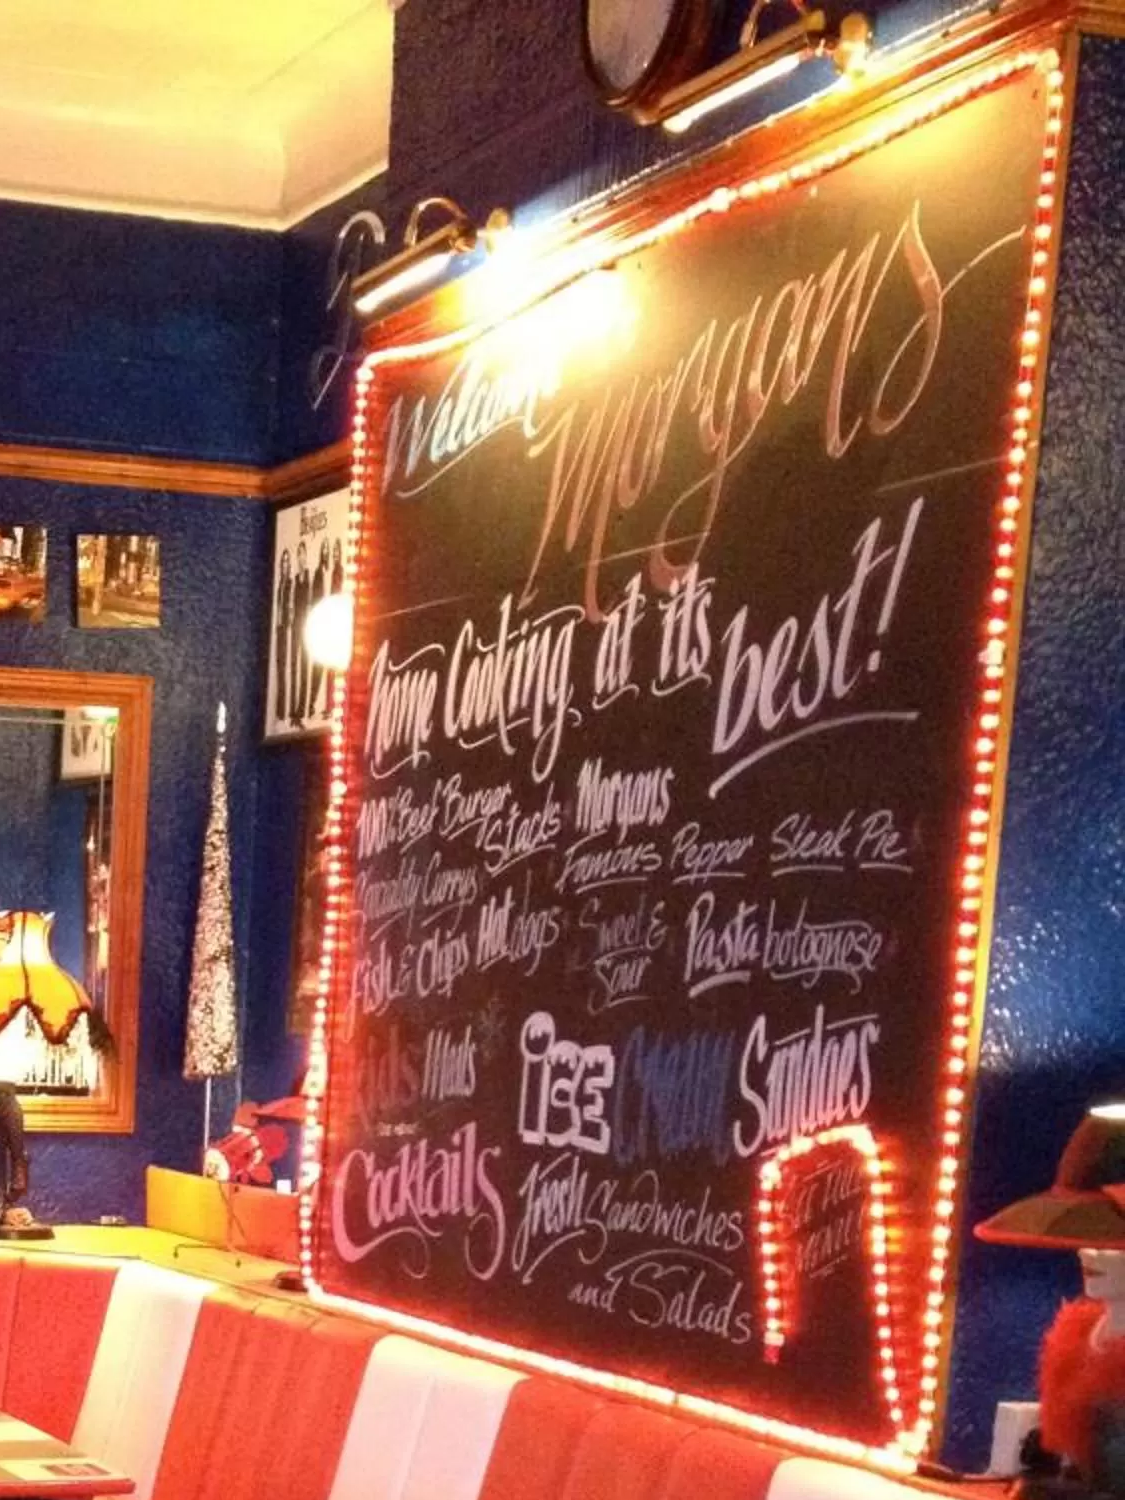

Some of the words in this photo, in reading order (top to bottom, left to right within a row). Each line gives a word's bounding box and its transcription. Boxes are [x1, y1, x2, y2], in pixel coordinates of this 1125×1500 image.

[382, 345, 555, 495] Welco
[519, 199, 1026, 622] Morgans
[593, 572, 645, 706] at
[659, 562, 715, 690] its
[712, 496, 924, 753] best!
[438, 772, 512, 838] Burger
[556, 829, 663, 893] Famous
[671, 822, 754, 883] Pepper
[771, 809, 856, 862] Steak
[855, 809, 907, 860] Pie
[576, 757, 674, 844] Morgans
[683, 891, 761, 982] Pasta
[734, 1004, 880, 1157] Sundaes
[332, 1121, 505, 1280] Cocktails
[579, 1169, 744, 1264] Sandwiches
[568, 1270, 624, 1313] and
[628, 1261, 752, 1345] Salads
